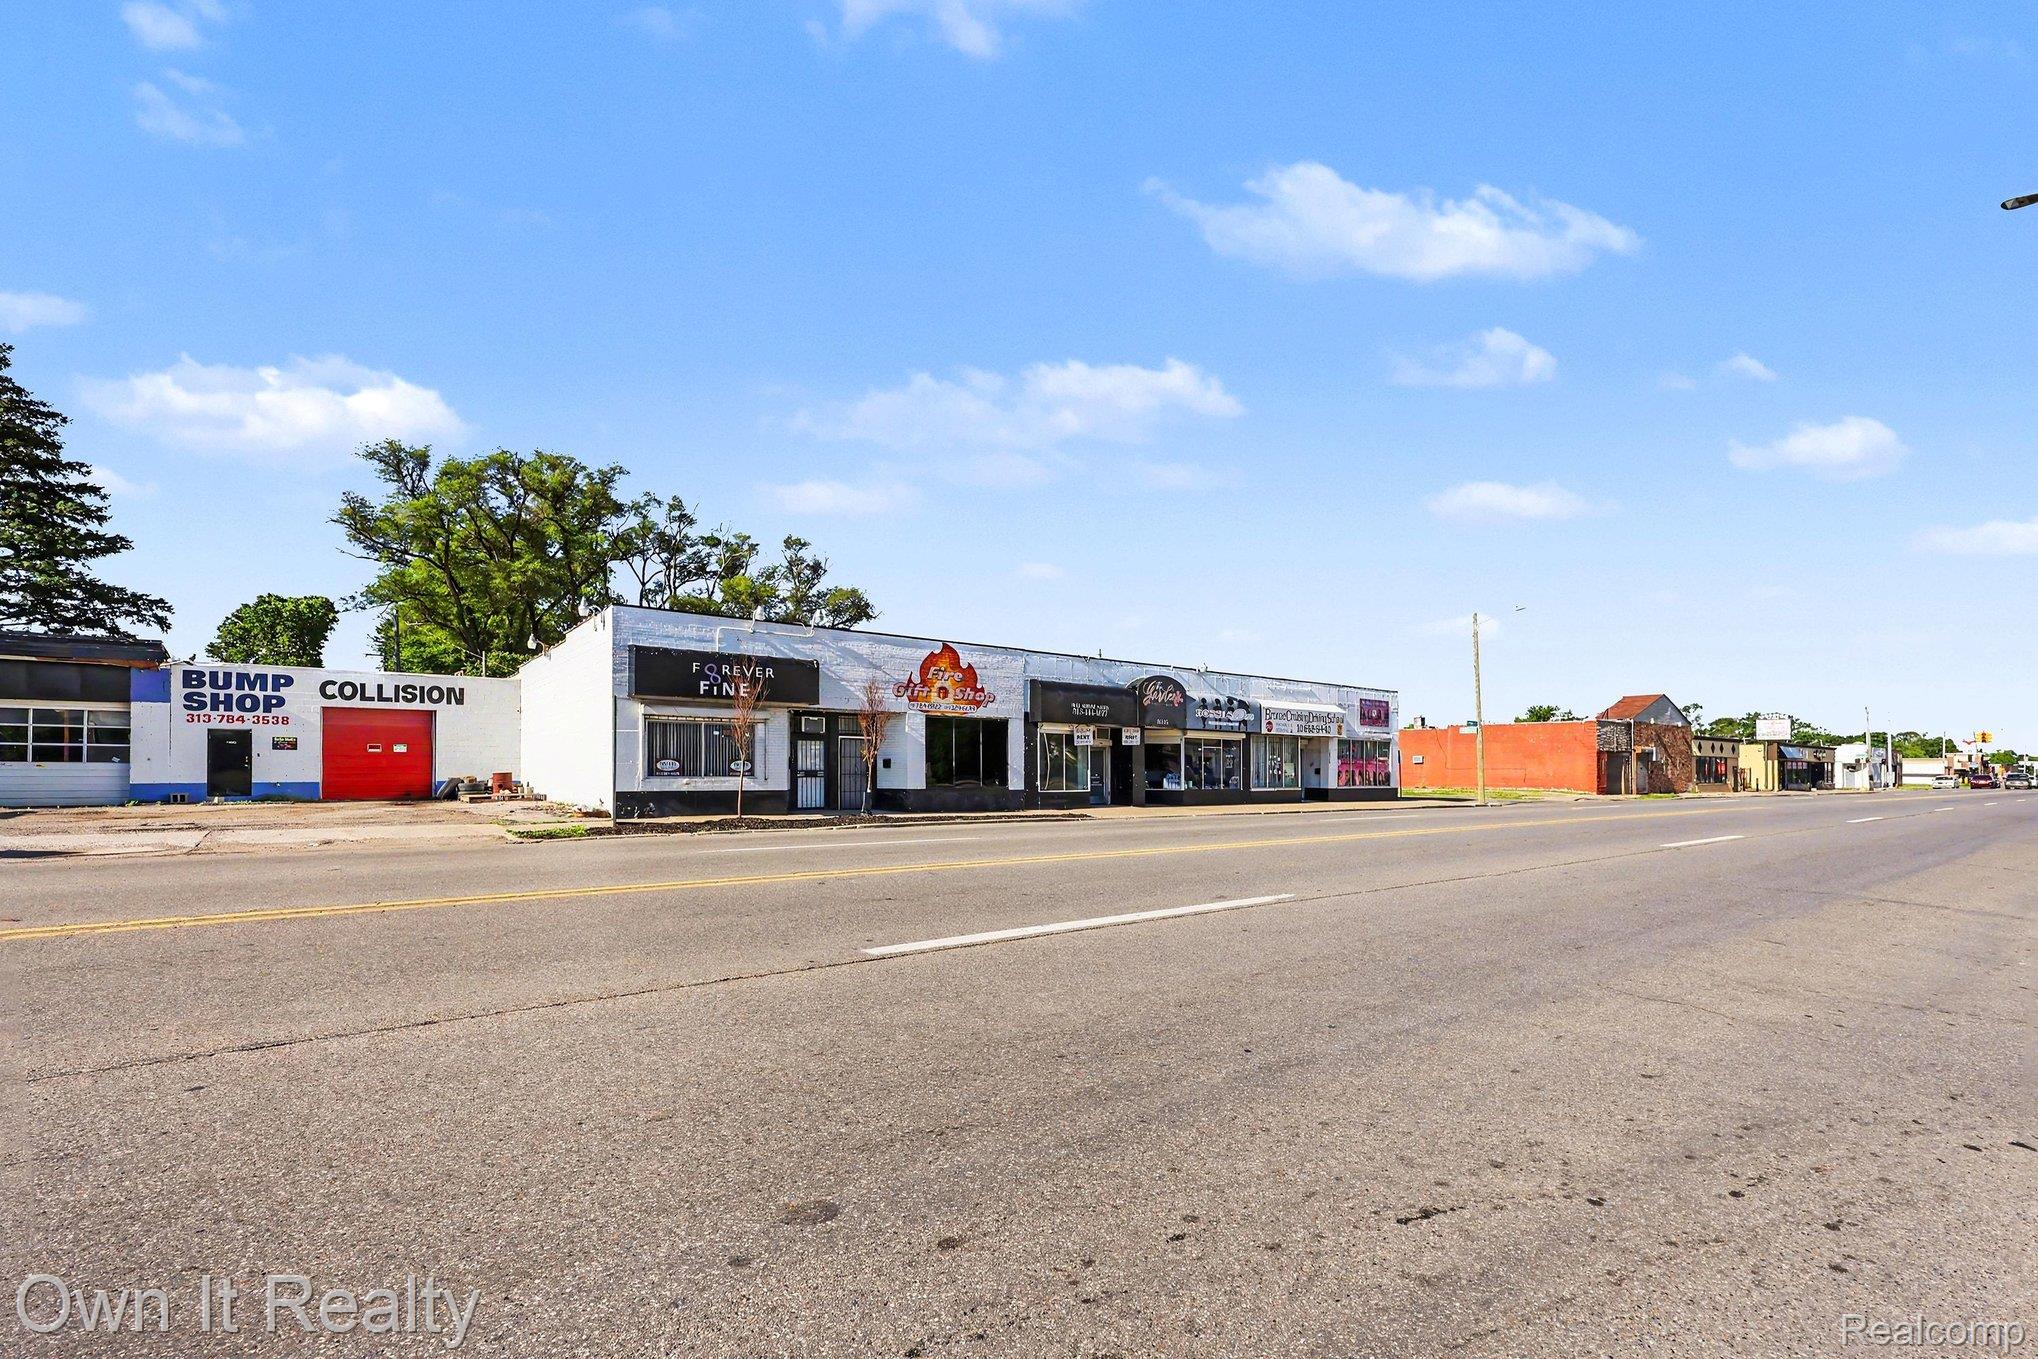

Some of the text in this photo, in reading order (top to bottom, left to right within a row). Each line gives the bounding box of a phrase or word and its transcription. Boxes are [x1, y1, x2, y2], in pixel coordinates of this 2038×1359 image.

[182, 669, 294, 692] BUMP
[927, 667, 964, 682] Fire
[182, 691, 286, 713] SHOP
[319, 680, 465, 705] COLLISION
[892, 681, 932, 698] Gift
[954, 687, 996, 708] Shop
[186, 713, 290, 725] 313-784-3538
